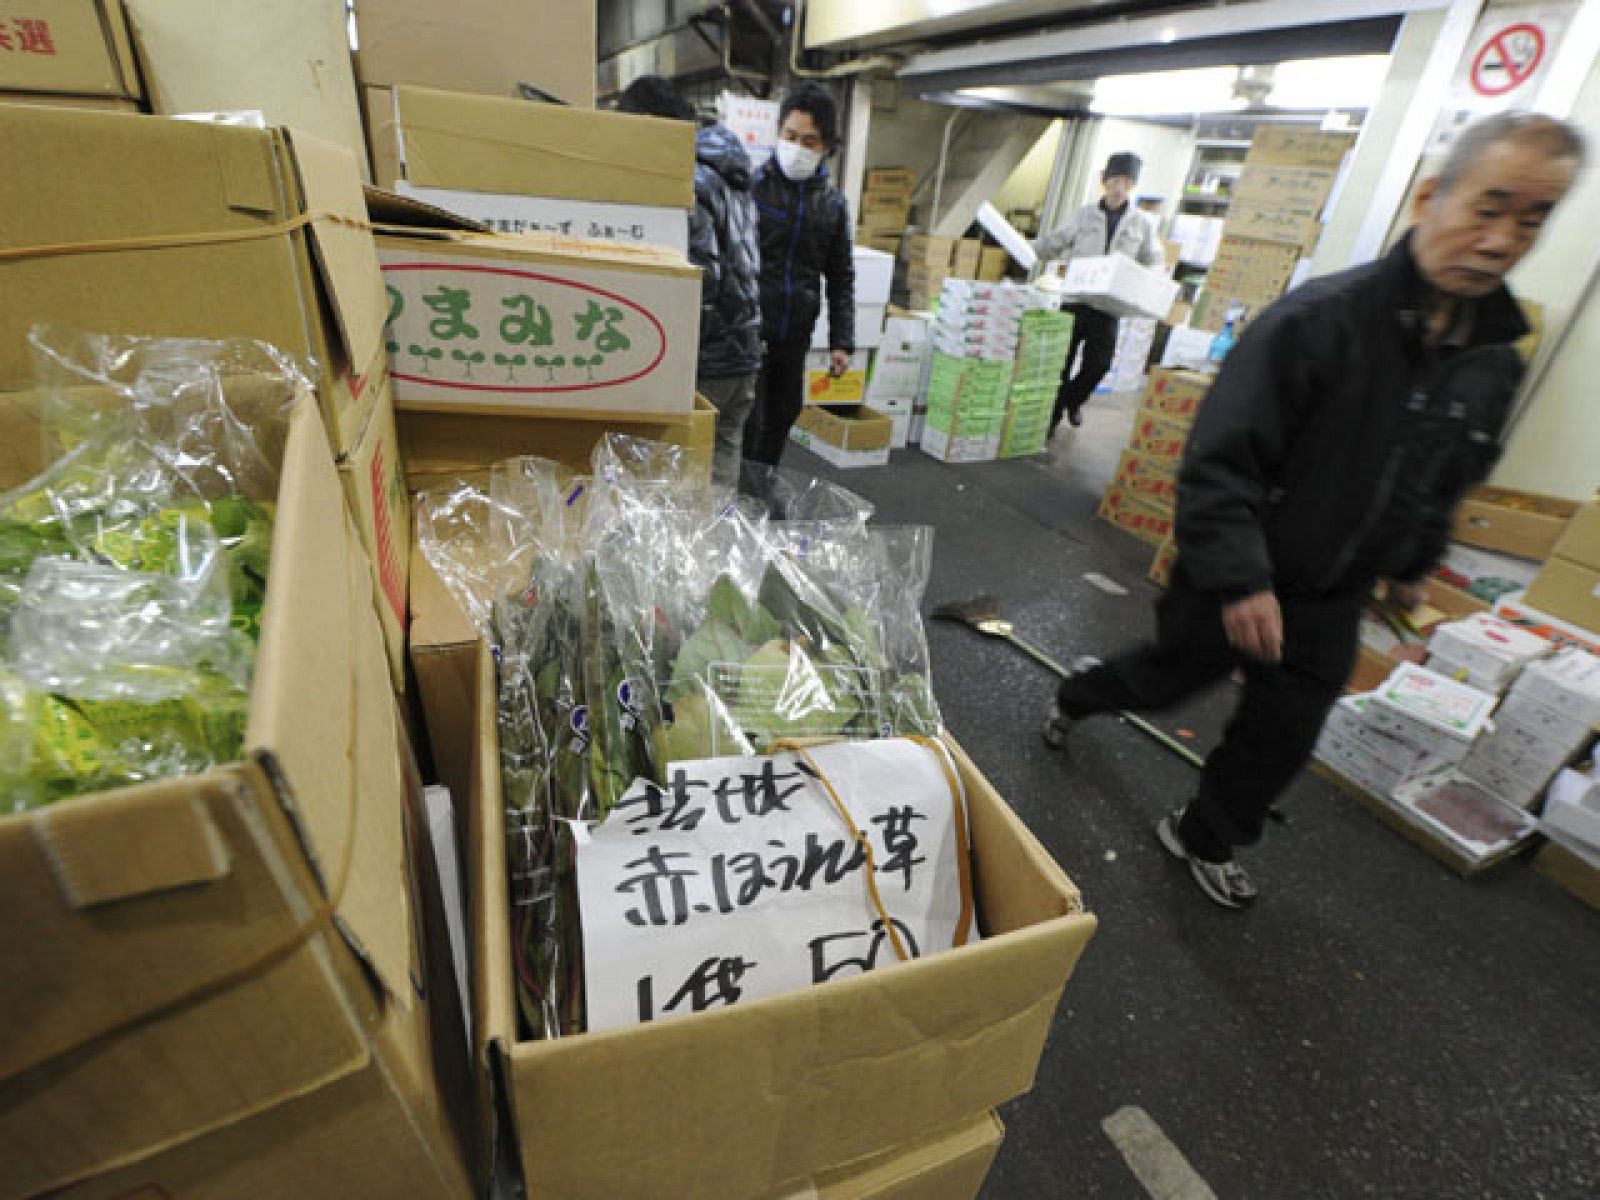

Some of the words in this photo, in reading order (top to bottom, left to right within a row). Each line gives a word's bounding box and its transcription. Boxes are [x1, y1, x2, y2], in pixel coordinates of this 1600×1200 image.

[614, 804, 928, 926] 赤ほうれん草
